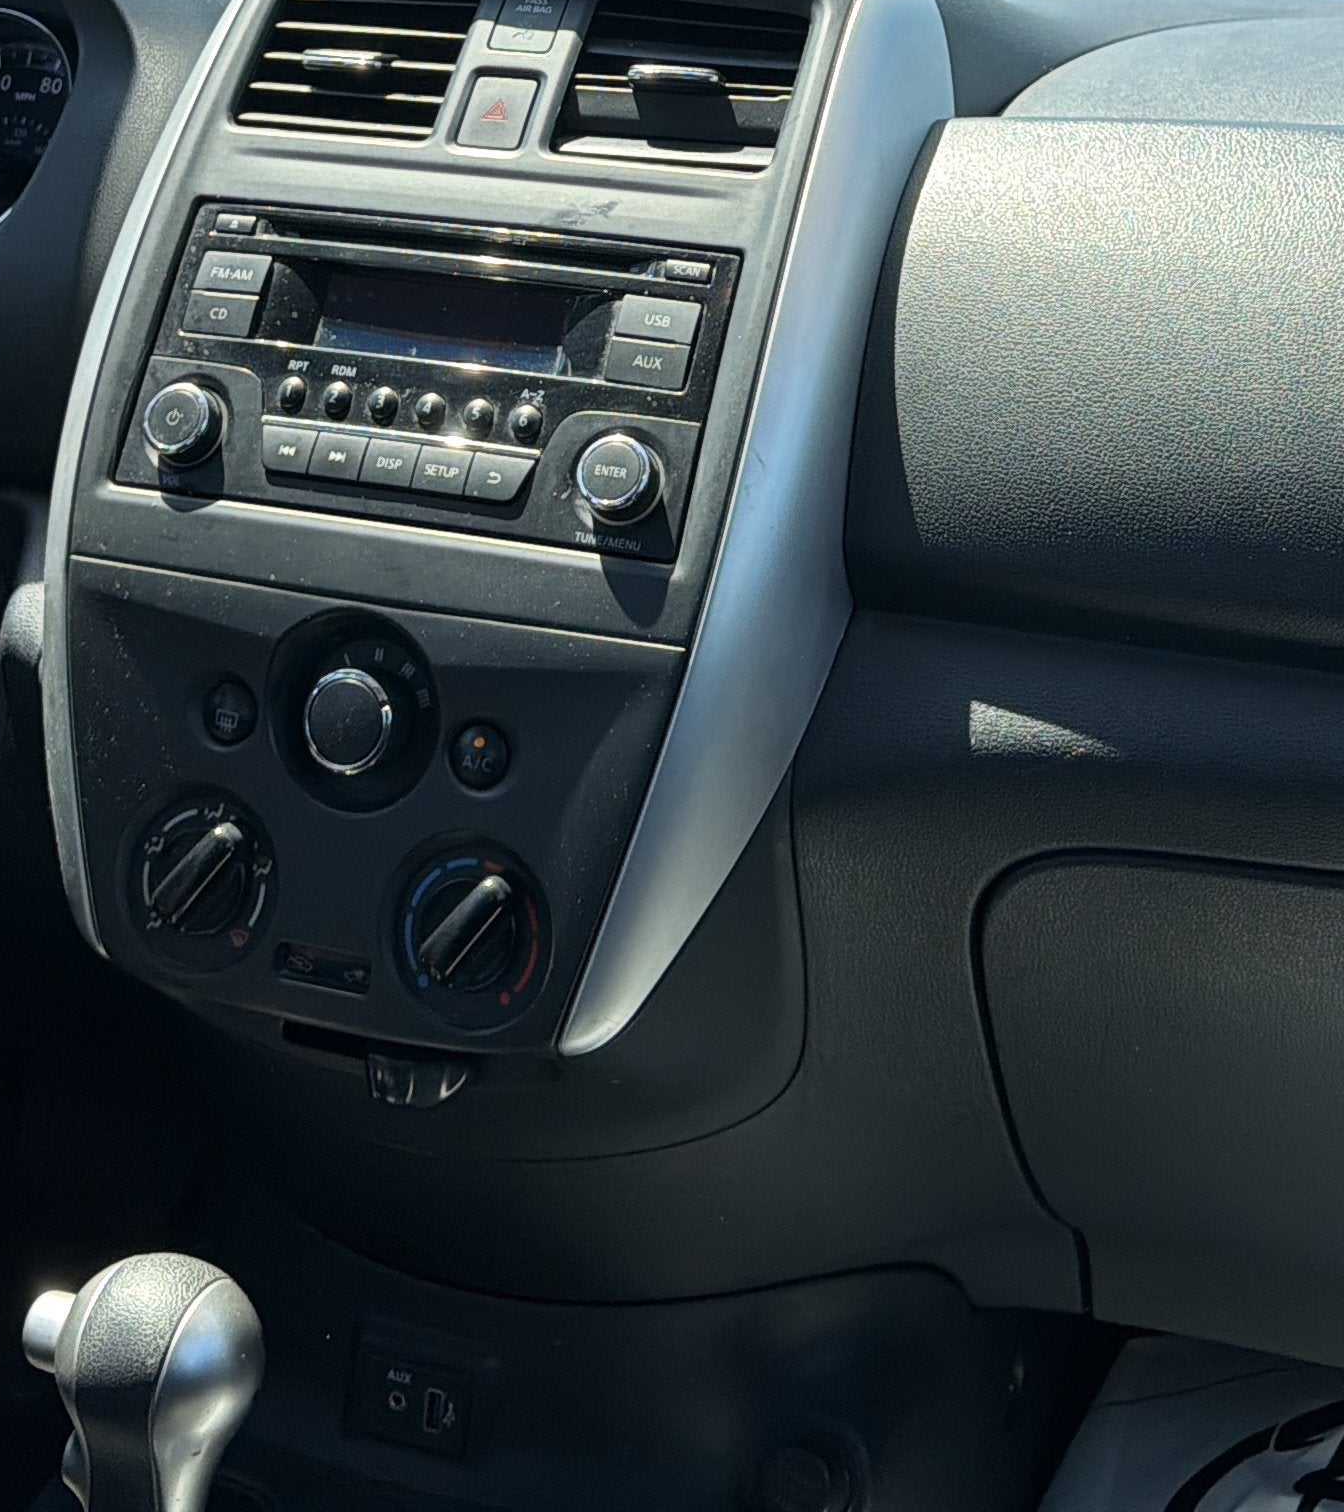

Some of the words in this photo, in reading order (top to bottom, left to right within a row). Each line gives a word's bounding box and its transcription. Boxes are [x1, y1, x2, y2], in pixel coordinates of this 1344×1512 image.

[515, 5, 532, 14] AIR
[532, 5, 554, 16] BAG
[39, 76, 63, 95] 80
[15, 91, 36, 102] MPH
[672, 263, 701, 278] SCAN
[209, 307, 229, 320] CD
[644, 312, 672, 328] USB
[288, 359, 310, 372] RPT
[631, 354, 665, 371] AUX
[331, 364, 357, 378] RDM
[285, 384, 293, 398] 1
[328, 390, 339, 404] 2
[375, 395, 386, 409] 3
[422, 402, 432, 416] 4
[471, 407, 482, 421] 5
[518, 416, 529, 428] 6
[376, 456, 404, 471] DISP
[423, 463, 460, 479] SETUP
[594, 464, 627, 479] ENTER
[574, 530, 642, 551] TUNE/MENU
[462, 754, 492, 773] A/C
[387, 1369, 412, 1385] AUX
